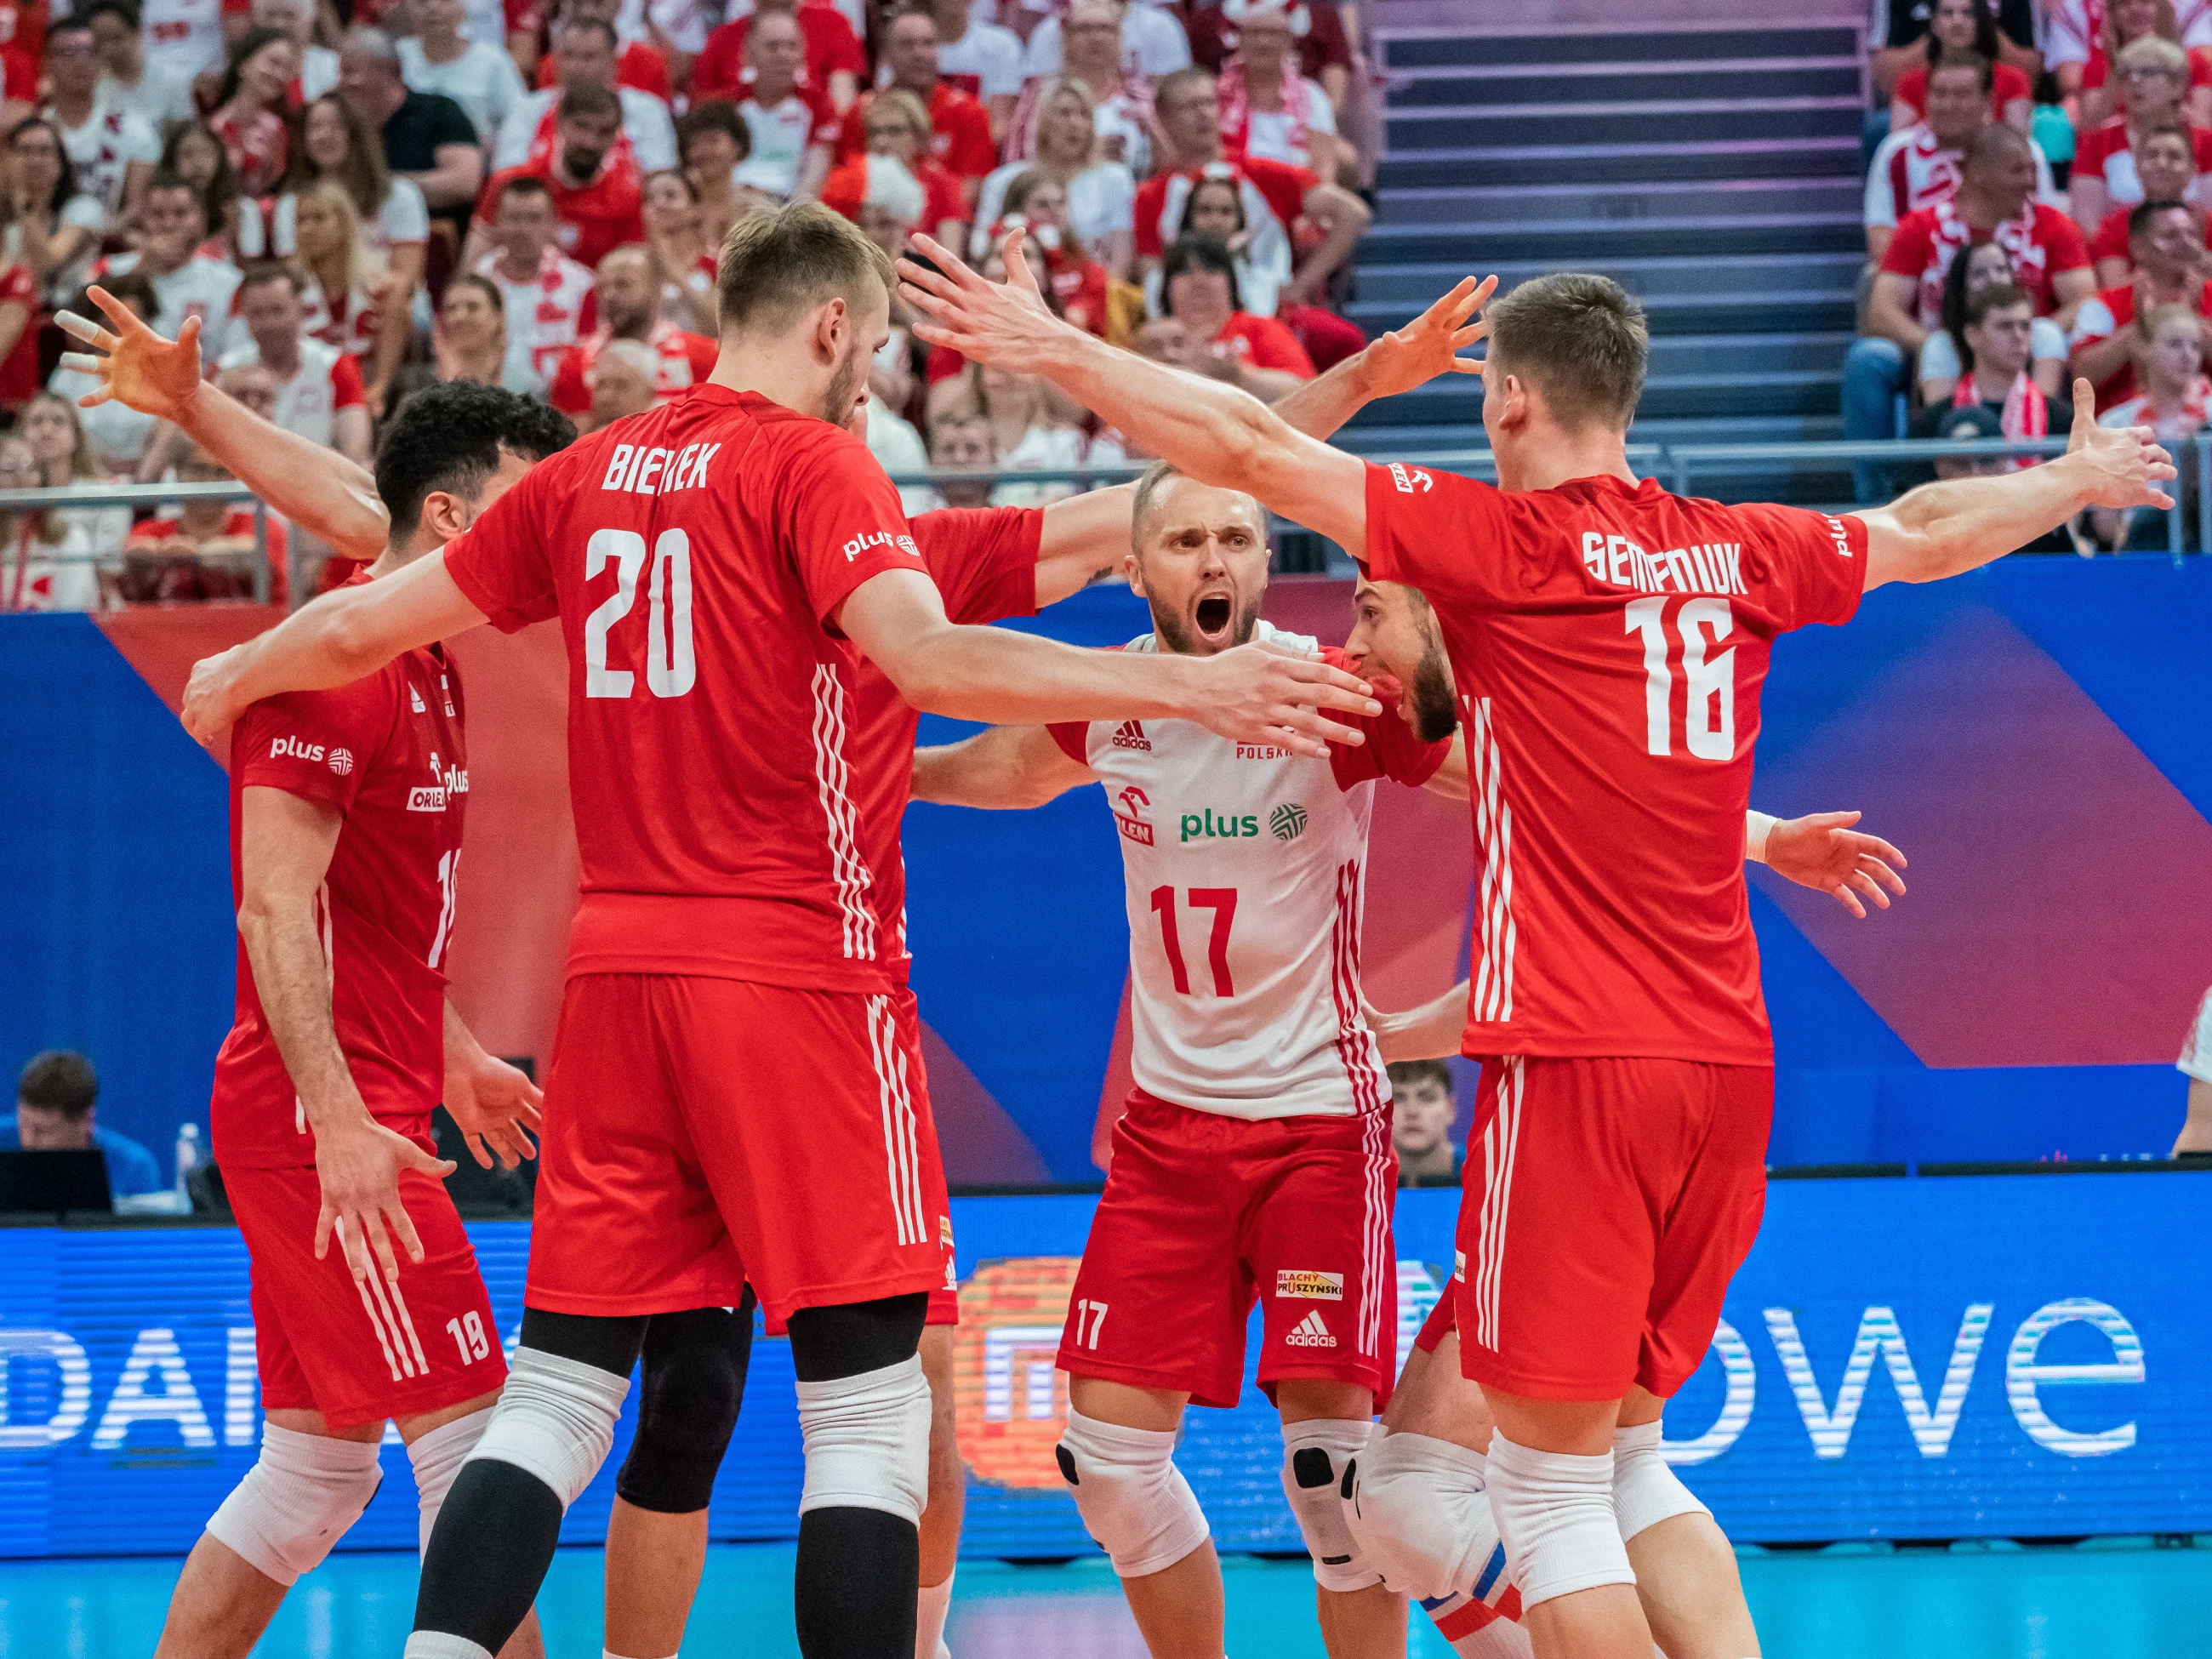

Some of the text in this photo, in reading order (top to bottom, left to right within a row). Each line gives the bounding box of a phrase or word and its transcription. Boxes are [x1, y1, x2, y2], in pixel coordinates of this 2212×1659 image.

[843, 531, 894, 562] plus
[1821, 514, 1853, 558] plu
[585, 527, 696, 698] 20
[1625, 596, 1736, 761] 16
[270, 735, 326, 762] plus
[1112, 735, 1152, 752] adidas
[444, 763, 470, 801] plus
[413, 791, 445, 808] ORLE
[1181, 808, 1259, 842] plus
[1150, 885, 1238, 998] 17
[1277, 1282, 1343, 1295] PRUSZYŃSKI
[1278, 1273, 1320, 1282] BLACHY
[446, 1310, 490, 1366] 19
[1077, 1298, 1109, 1350] 17
[1286, 1333, 1337, 1348] adidas
